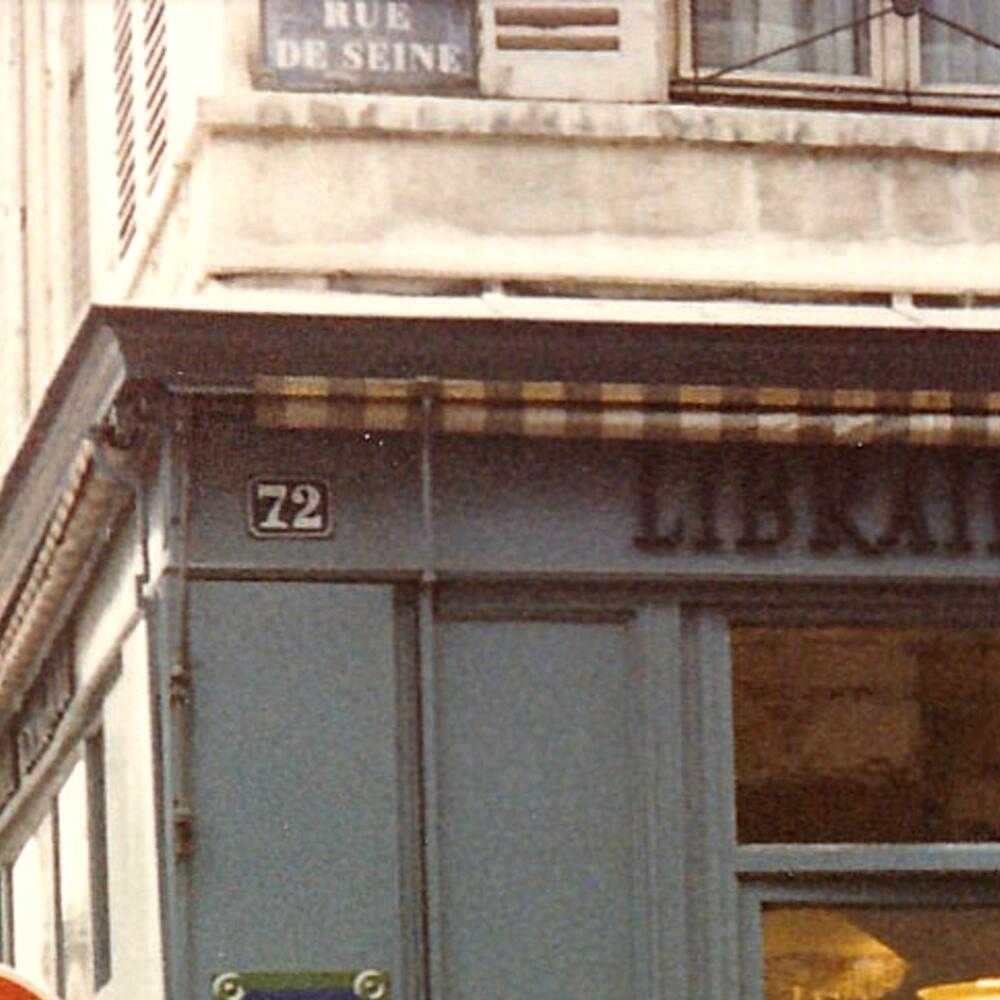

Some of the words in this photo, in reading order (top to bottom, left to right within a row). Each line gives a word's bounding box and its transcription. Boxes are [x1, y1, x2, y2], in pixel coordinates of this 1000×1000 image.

[323, 0, 411, 31] RUE
[276, 39, 327, 70] DE
[341, 43, 463, 74] SEINE
[257, 484, 322, 529] 72
